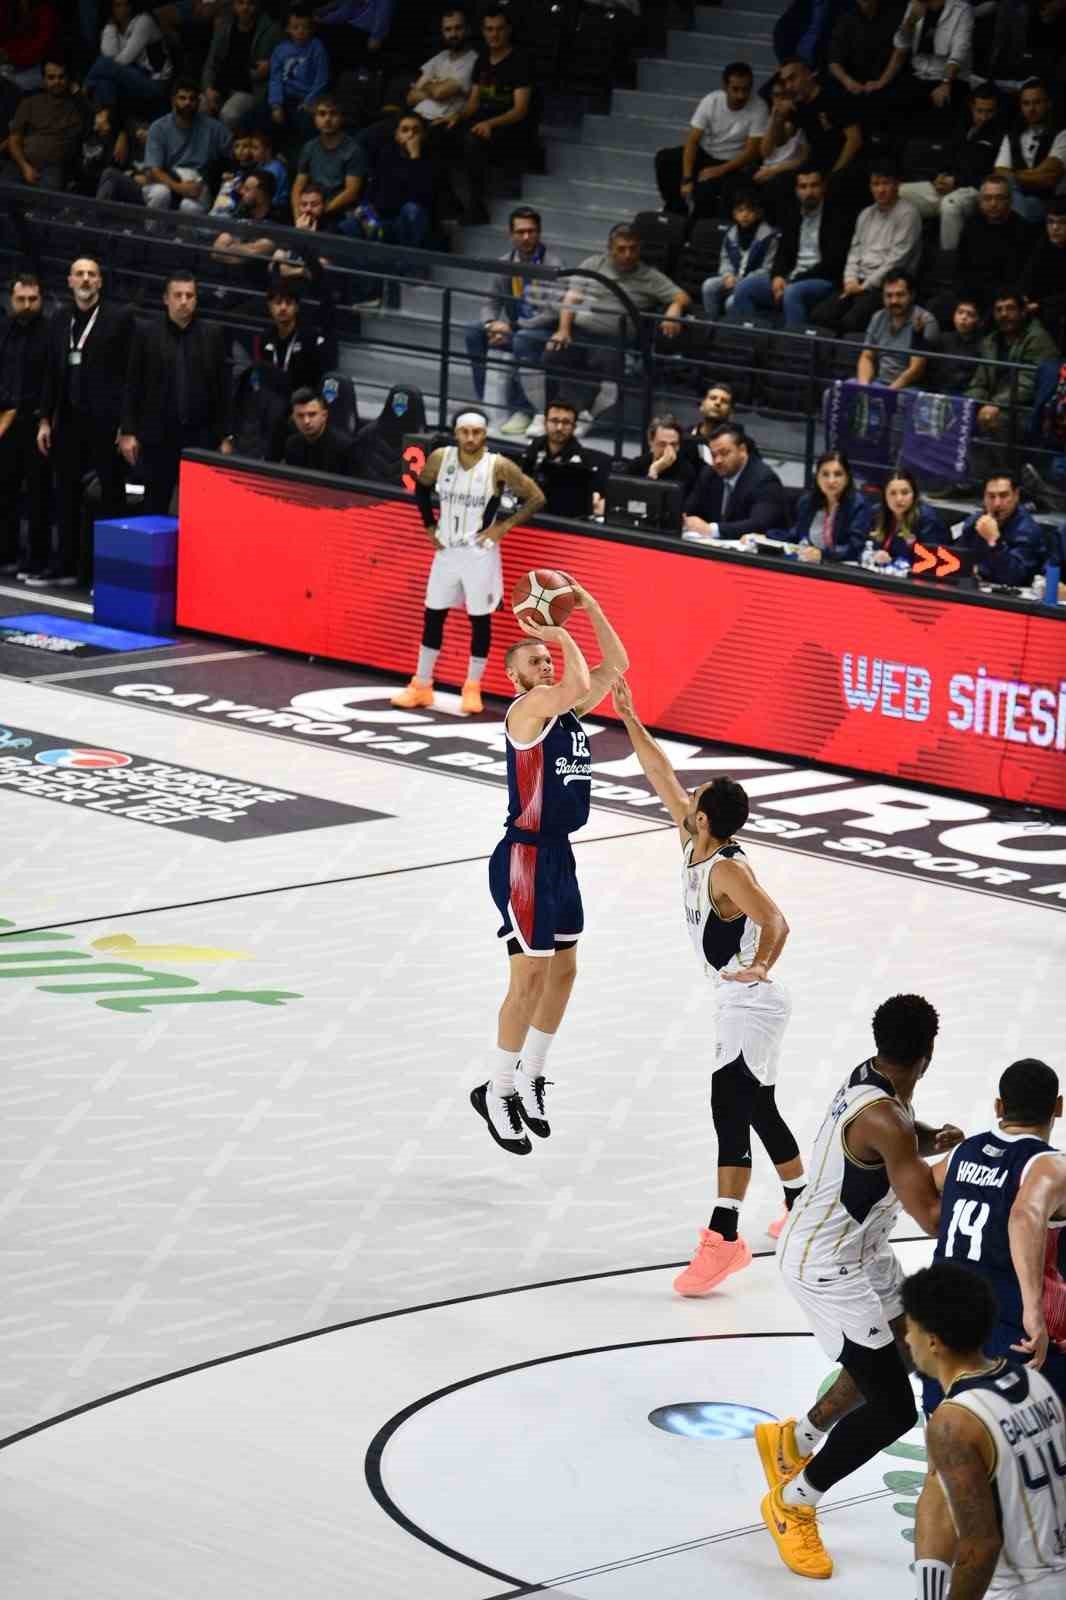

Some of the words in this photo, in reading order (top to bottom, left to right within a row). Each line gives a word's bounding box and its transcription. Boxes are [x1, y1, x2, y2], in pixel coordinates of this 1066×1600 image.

[842, 652, 932, 722] WEB
[823, 837, 1031, 885] SPOR
[945, 1199, 991, 1262] 14
